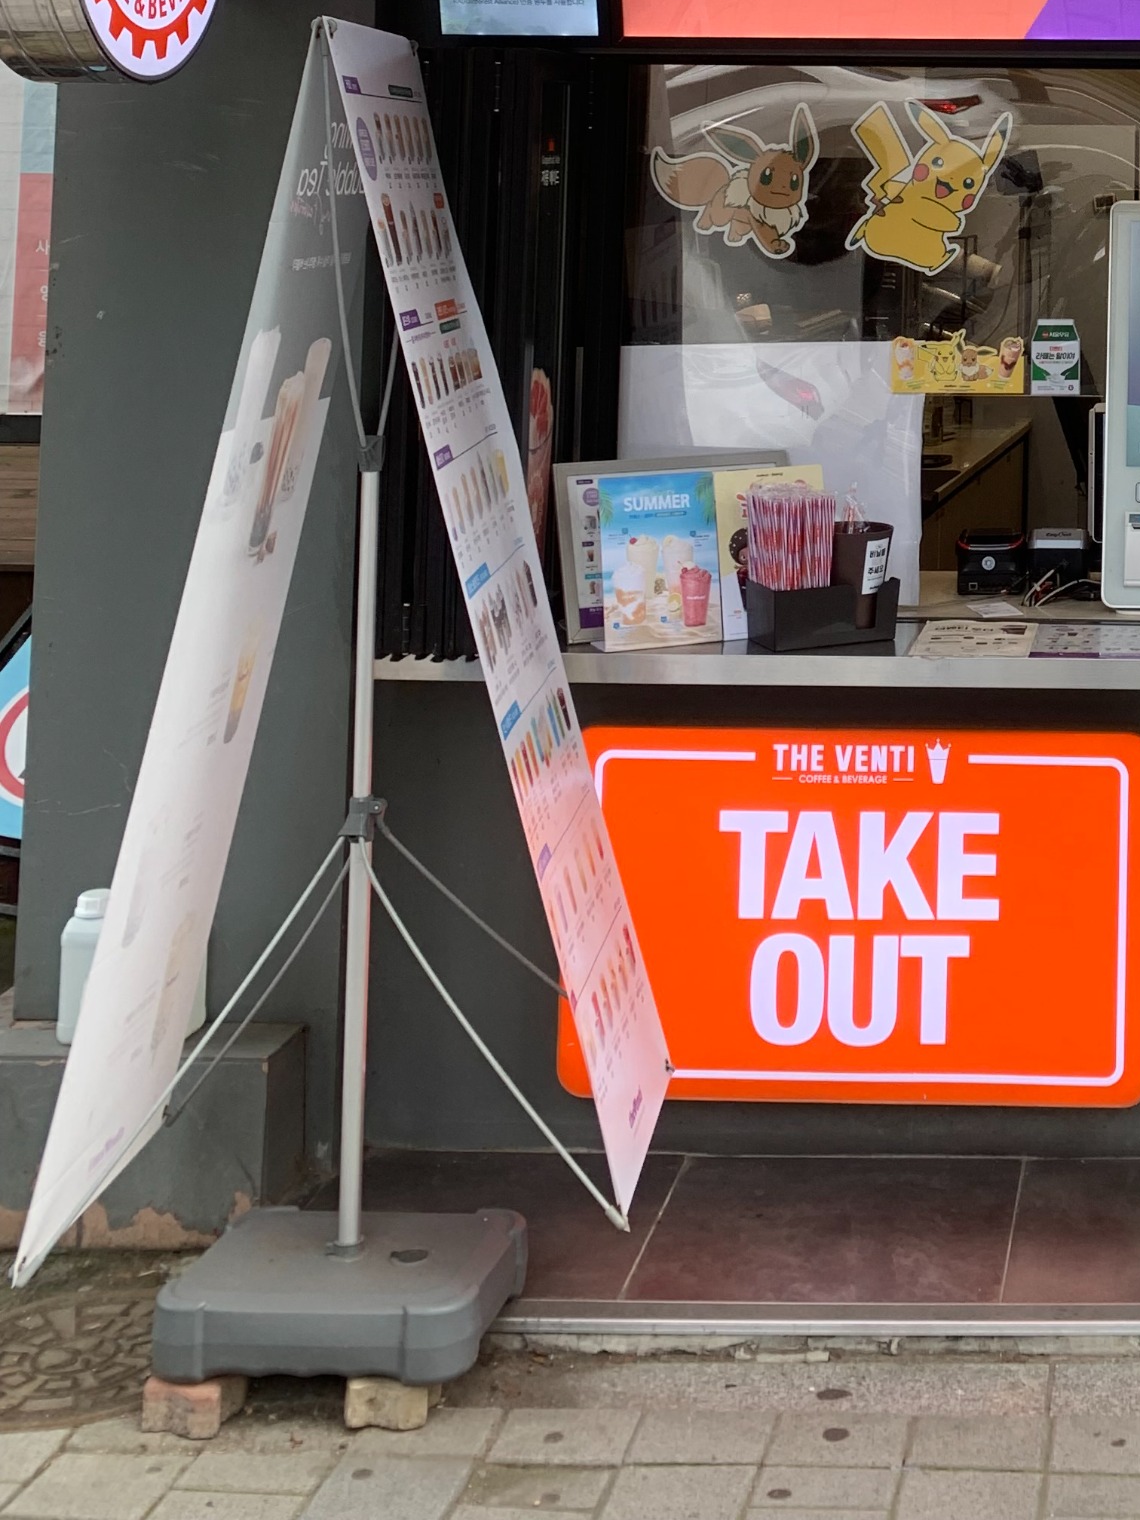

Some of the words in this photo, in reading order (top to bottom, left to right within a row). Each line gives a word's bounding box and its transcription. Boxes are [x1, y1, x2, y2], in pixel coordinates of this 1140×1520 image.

[623, 493, 691, 513] SUMMER
[772, 743, 825, 773] THE
[836, 744, 916, 774] VENTI
[798, 774, 833, 784] COFFEE
[841, 775, 888, 785] BEVERAGE
[718, 810, 1001, 921] TAKE
[749, 932, 970, 1047] OUT
